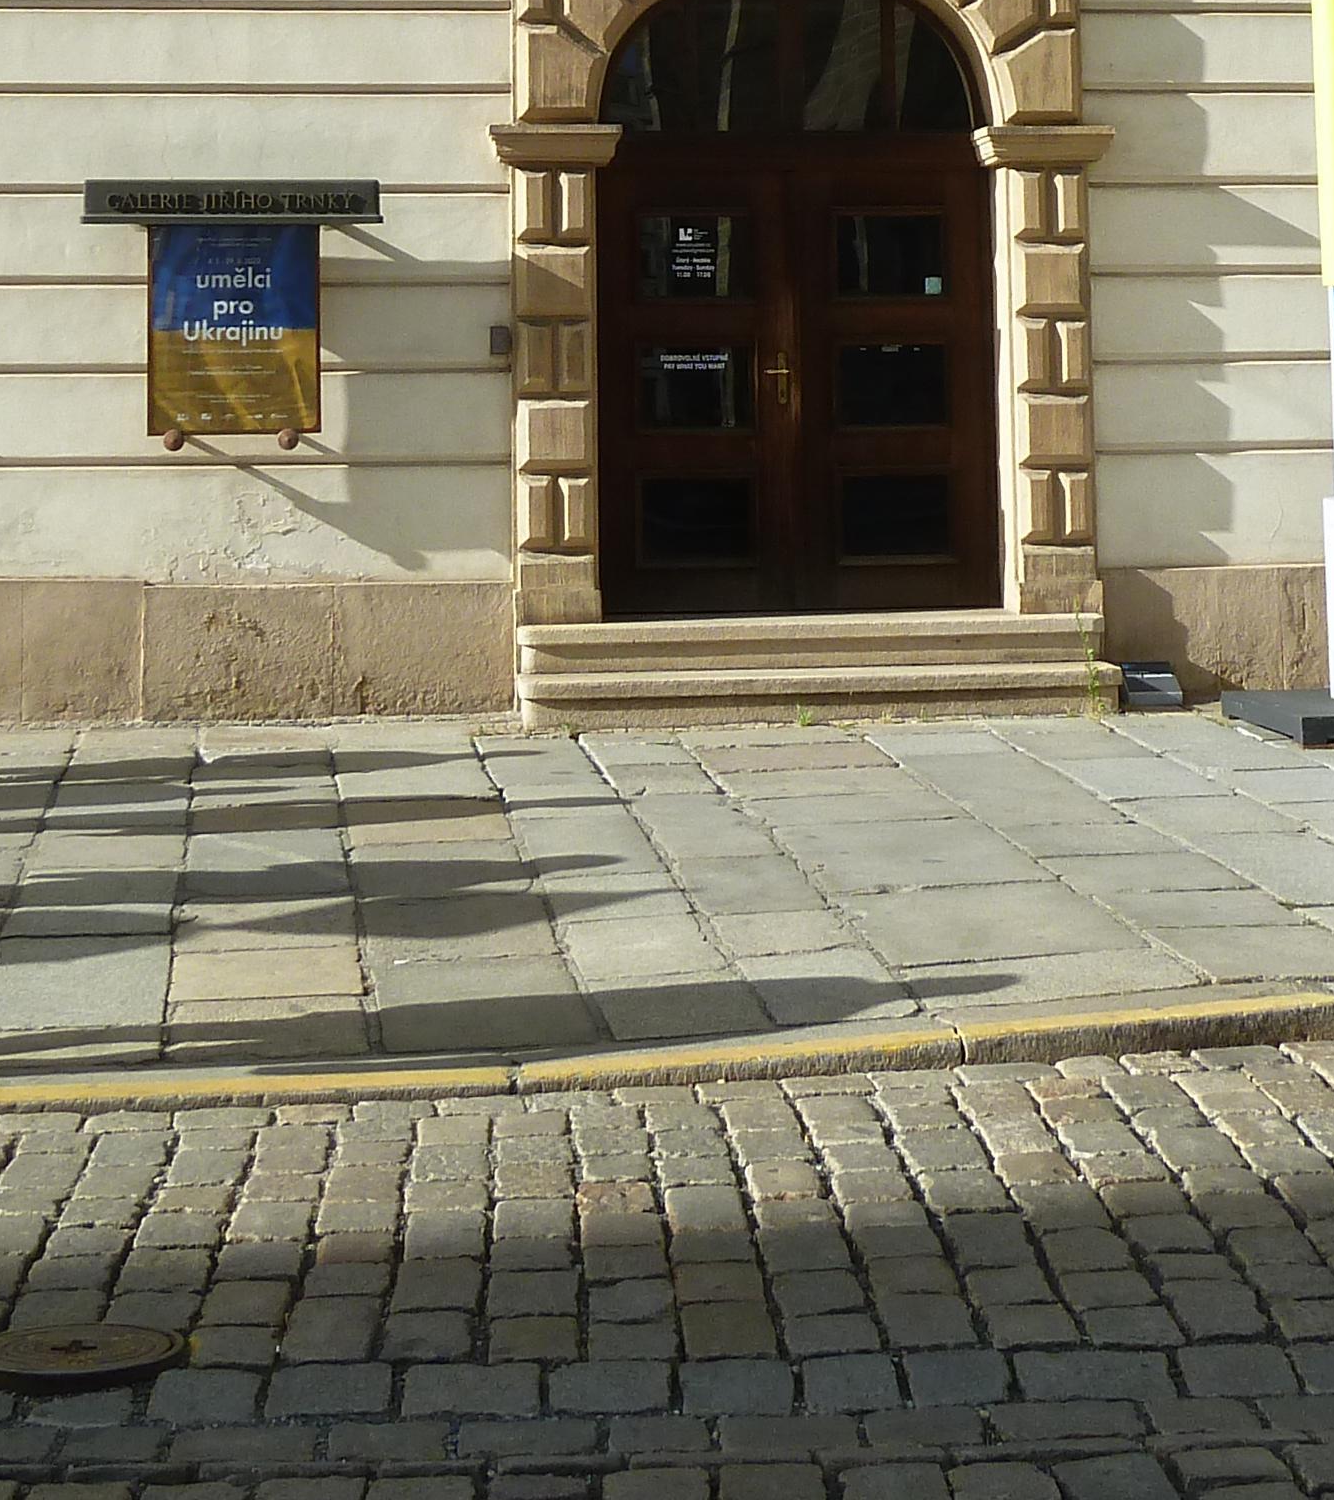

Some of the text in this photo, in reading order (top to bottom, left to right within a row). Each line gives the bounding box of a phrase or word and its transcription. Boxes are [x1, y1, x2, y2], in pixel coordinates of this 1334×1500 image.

[106, 188, 354, 212] GALERIE JIŘÍHO TRNKY
[195, 266, 272, 289] umělci
[213, 300, 255, 321] pro
[183, 319, 284, 347] Ukrajinu
